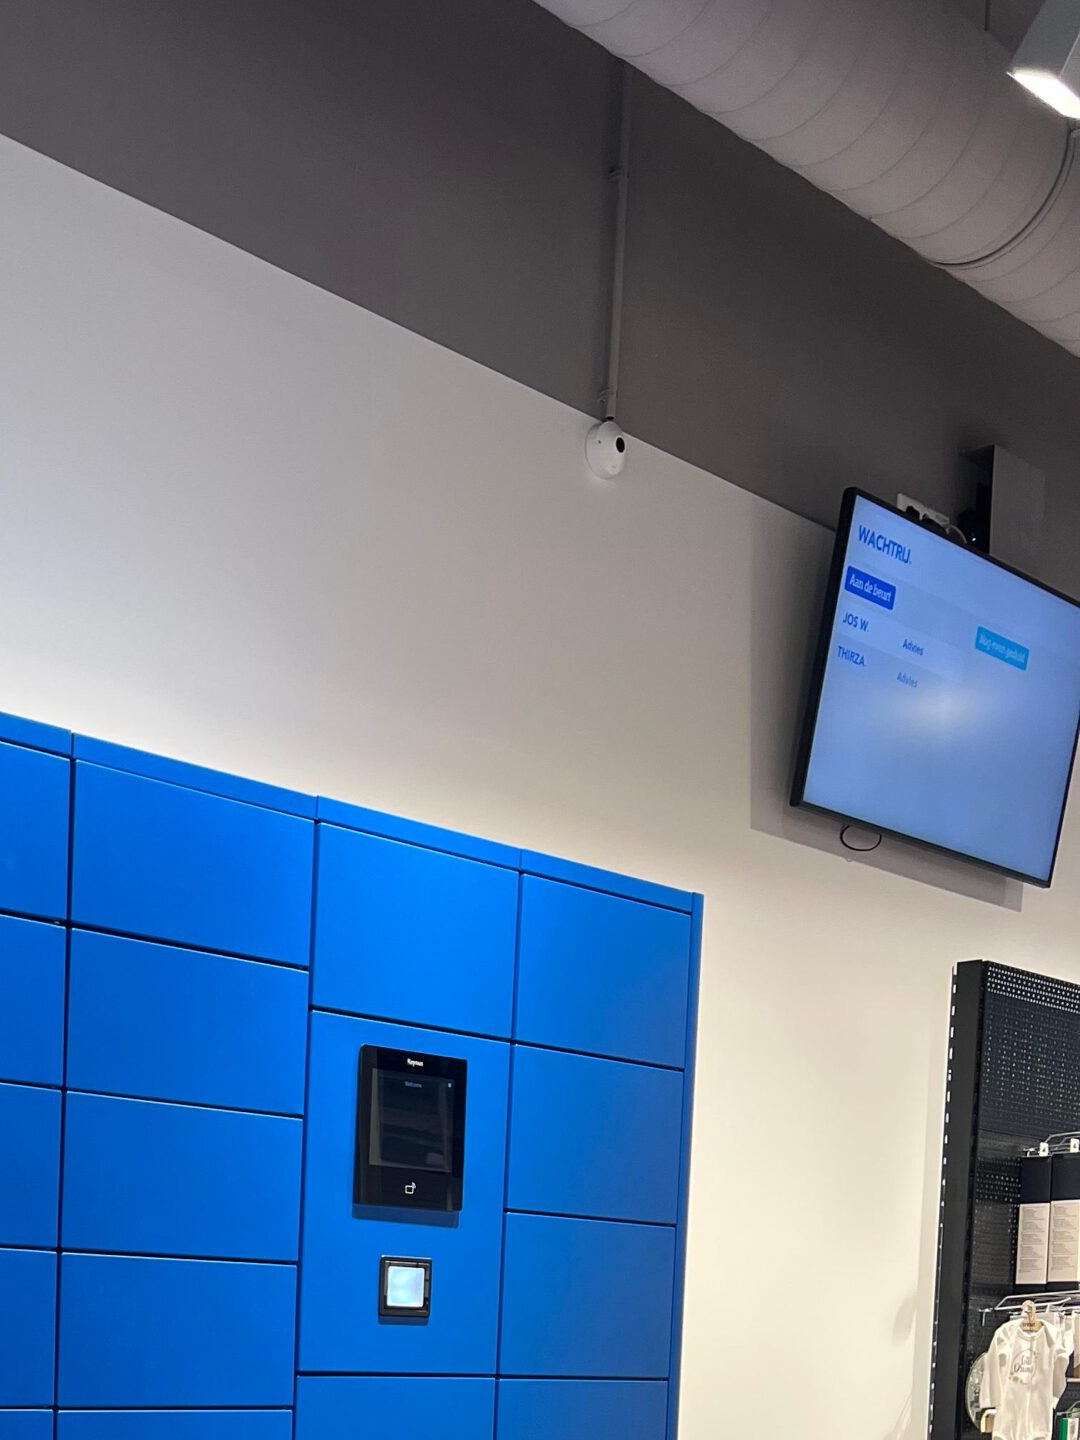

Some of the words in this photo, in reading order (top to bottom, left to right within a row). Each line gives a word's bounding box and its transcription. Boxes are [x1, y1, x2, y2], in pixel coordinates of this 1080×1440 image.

[849, 574, 863, 590] Aan
[863, 580, 873, 594] de
[872, 584, 891, 602] beurt
[842, 612, 858, 628] JOS
[902, 639, 924, 657] Advies
[896, 671, 918, 689] Advies
